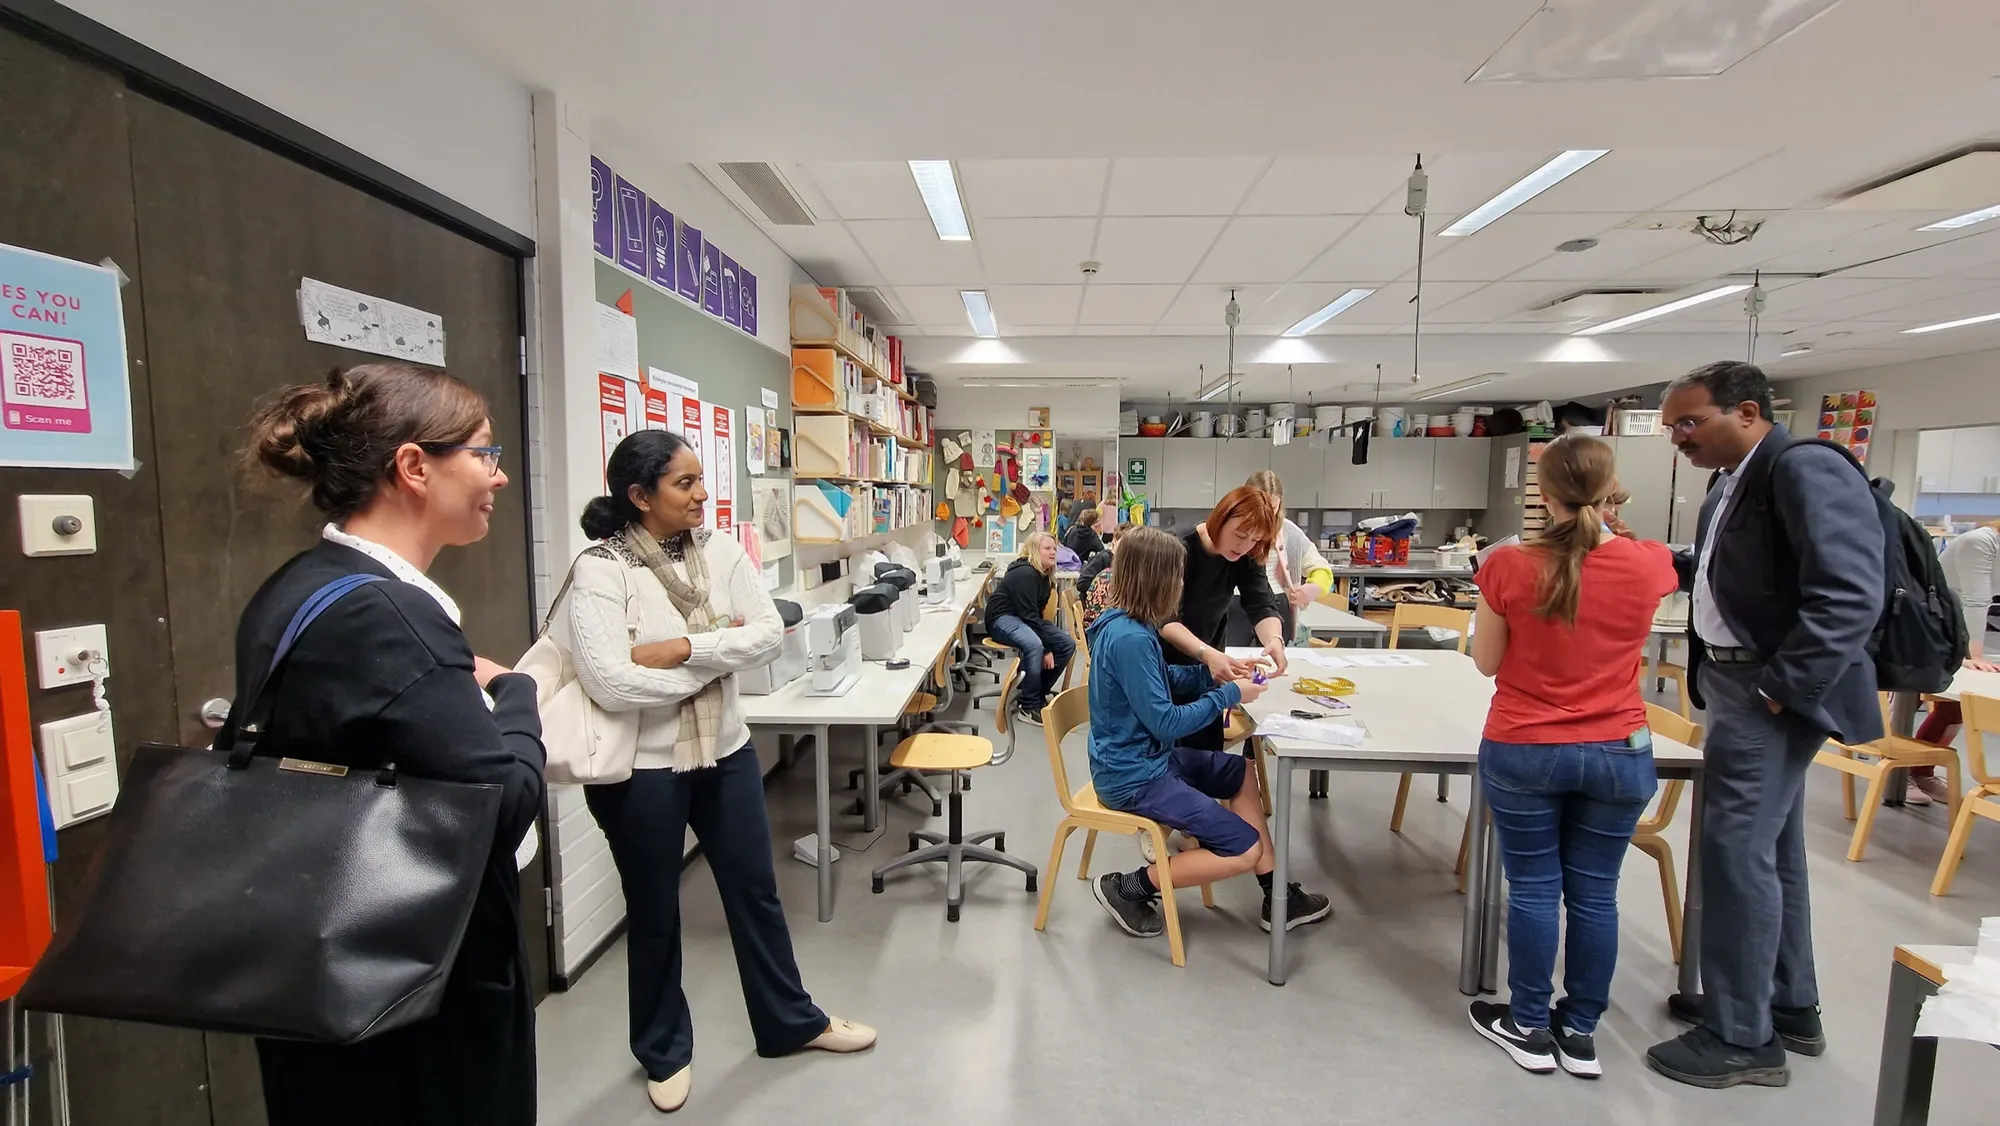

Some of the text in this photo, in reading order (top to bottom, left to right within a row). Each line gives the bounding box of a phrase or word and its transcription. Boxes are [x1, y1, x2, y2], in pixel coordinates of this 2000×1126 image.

[0, 284, 80, 310] ES YOU
[12, 304, 66, 325] CAN!
[25, 415, 72, 426] Scan me
